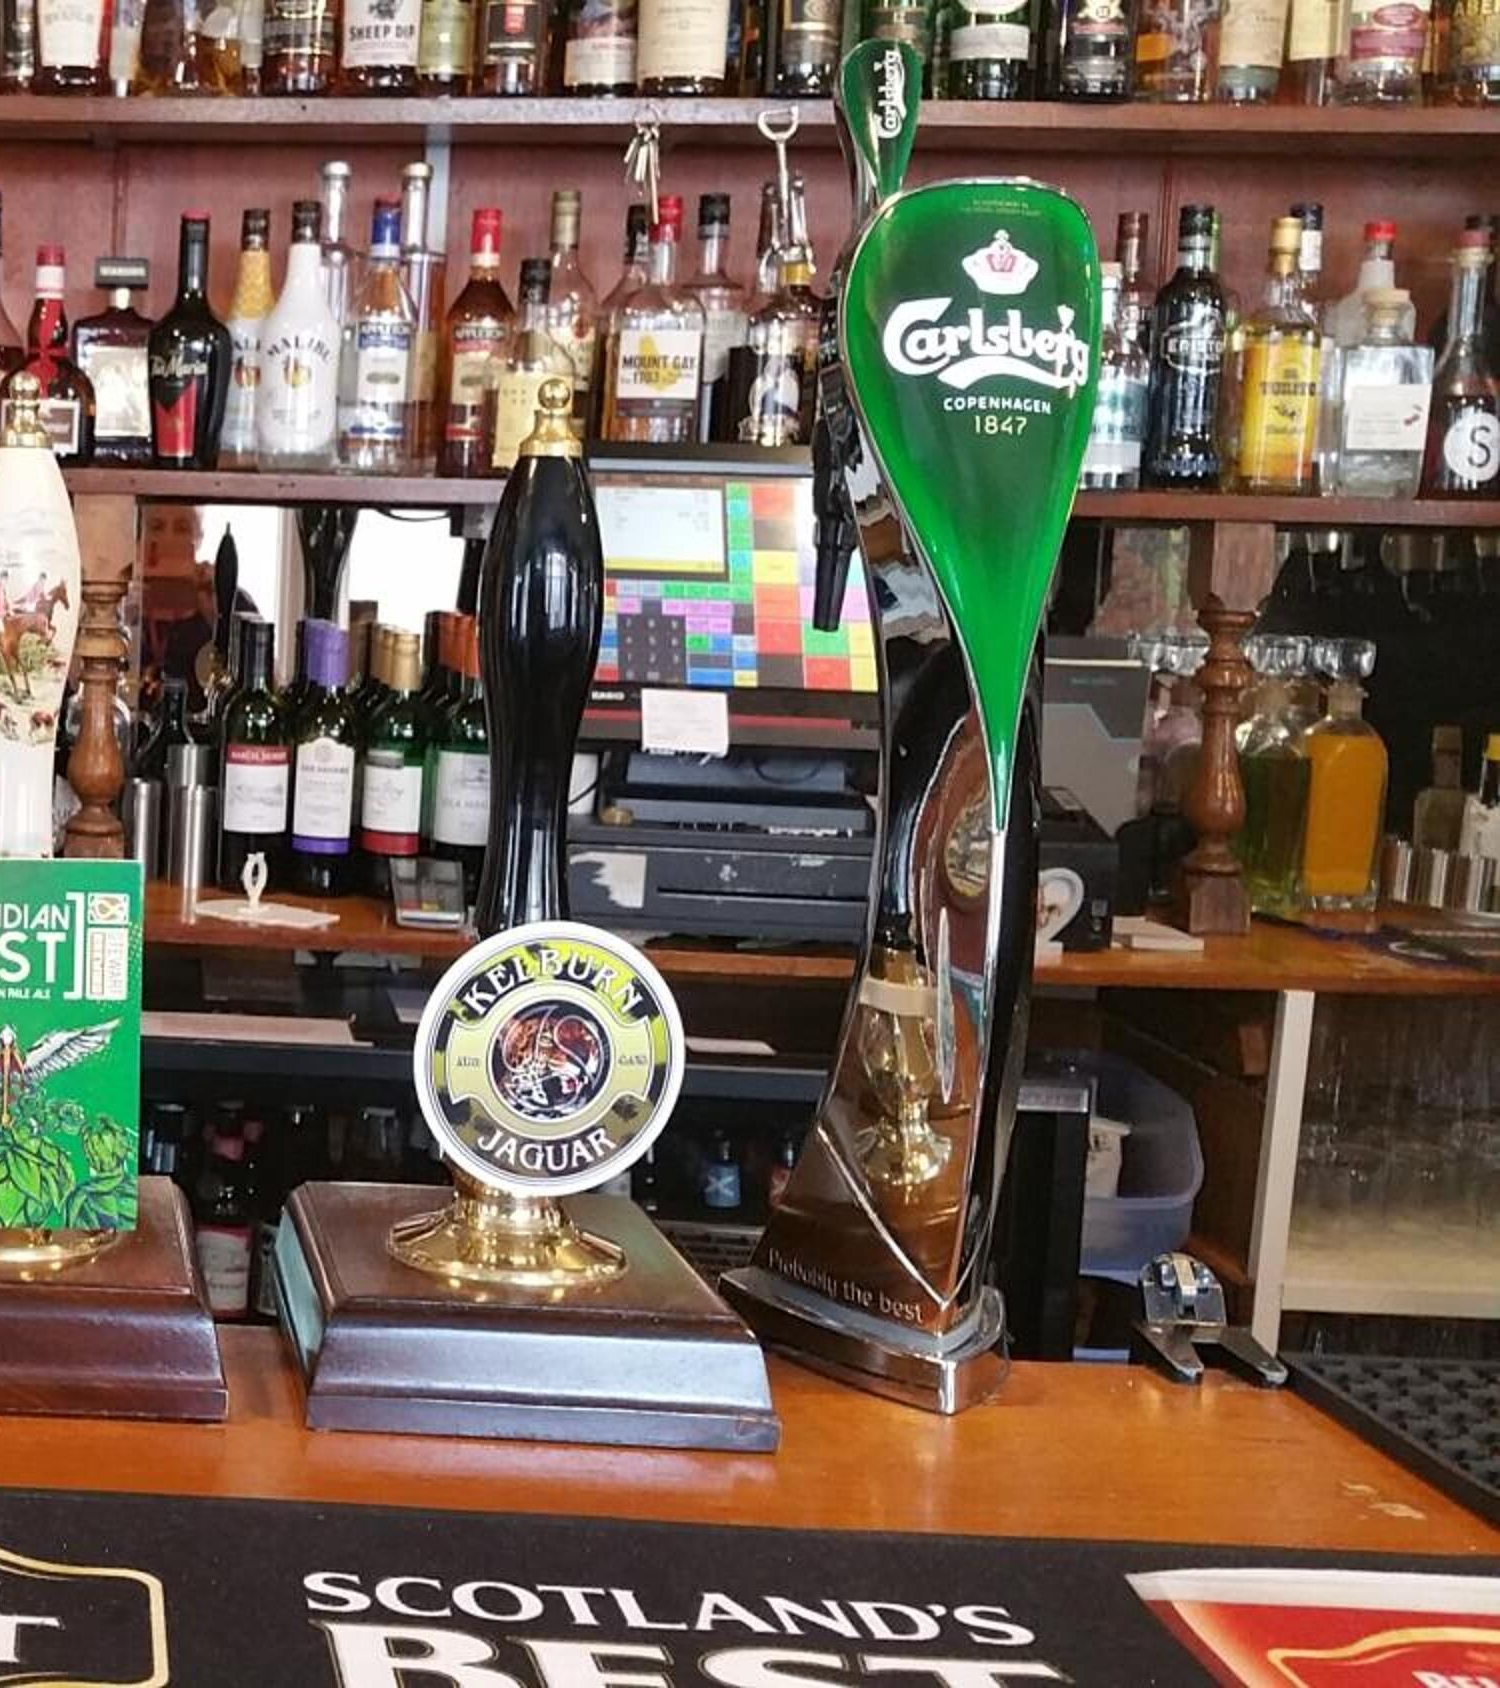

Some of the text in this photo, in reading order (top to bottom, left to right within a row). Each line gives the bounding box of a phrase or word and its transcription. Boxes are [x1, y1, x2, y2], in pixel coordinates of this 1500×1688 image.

[349, 23, 415, 42] SHEEP DIP
[873, 48, 908, 139] Carlsberg
[622, 354, 697, 370] MOUNT GAY
[882, 296, 1091, 399] Carlsberg
[943, 396, 1051, 415] COPENHAGEN
[974, 414, 1029, 436] 1847
[7, 987, 31, 999] PALE
[33, 987, 53, 1000] ALE
[462, 947, 645, 1017] KELBURN
[477, 1127, 619, 1173] JAGUAR
[767, 1247, 924, 1325] Probably the best
[301, 1570, 1037, 1647] SCOTLAND'S
